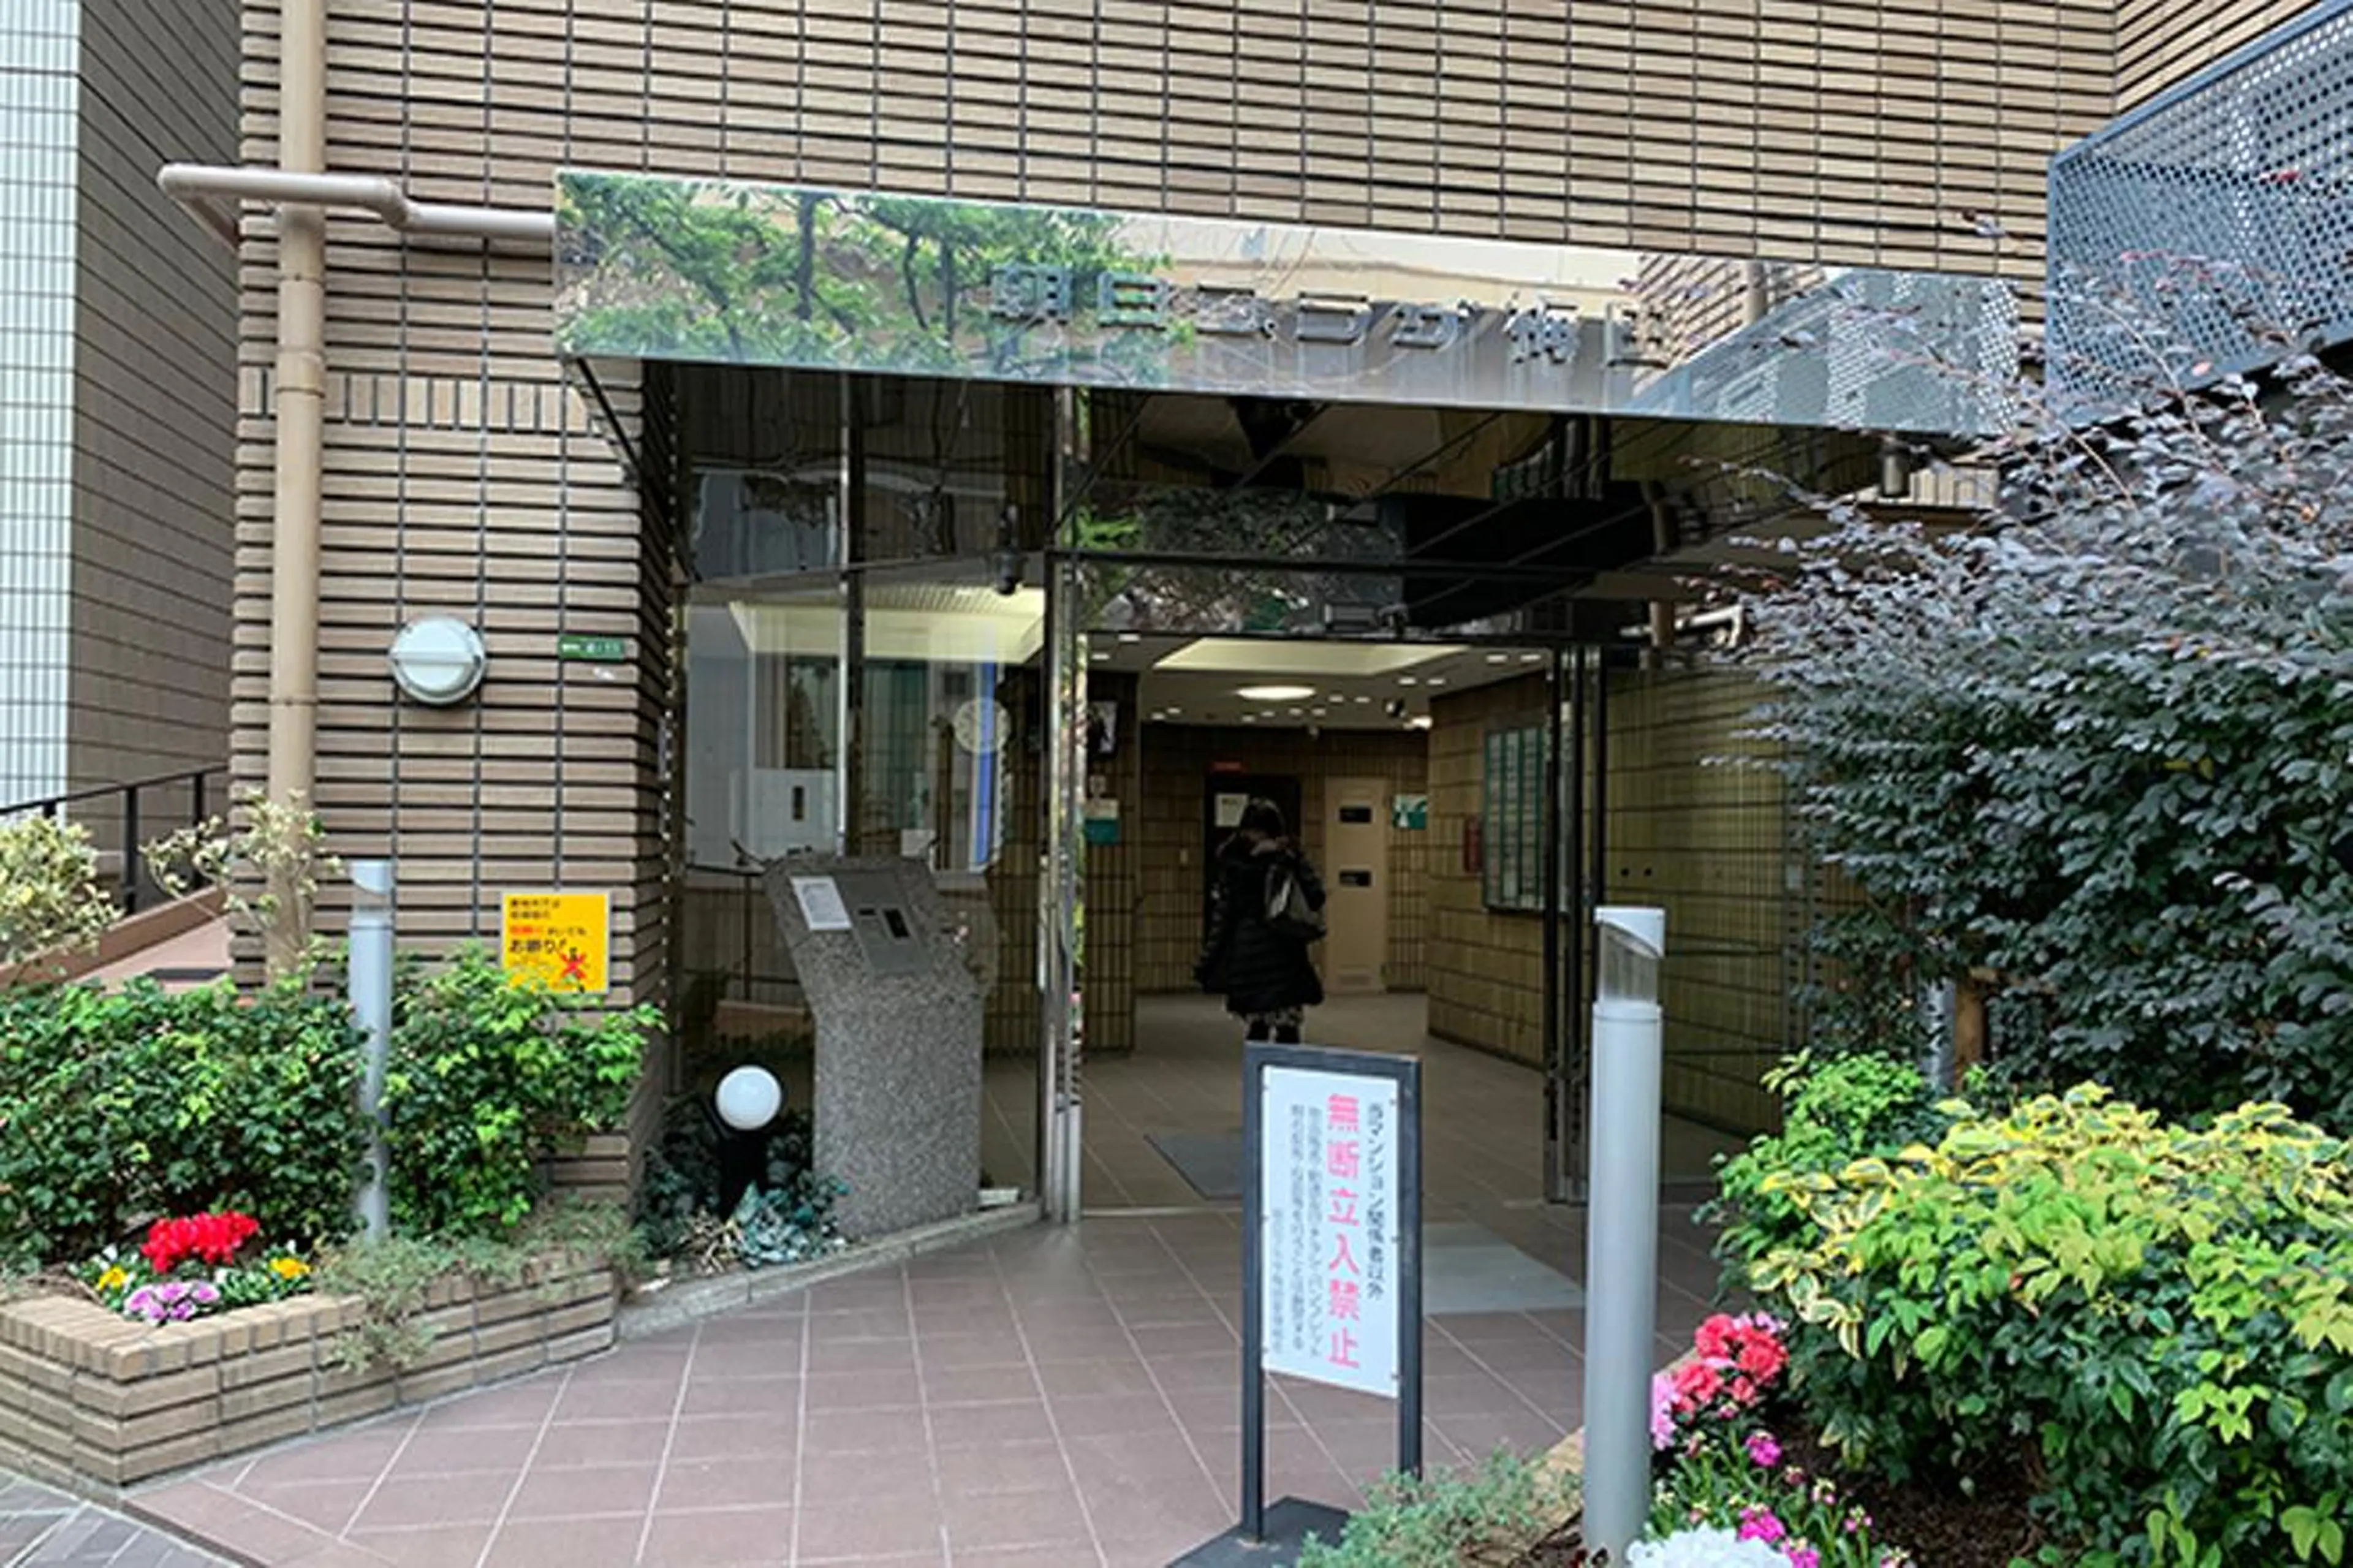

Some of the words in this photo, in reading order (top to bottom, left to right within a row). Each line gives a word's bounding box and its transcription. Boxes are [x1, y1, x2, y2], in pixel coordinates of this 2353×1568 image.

[1326, 1093, 1360, 1369] 無断立入禁止
